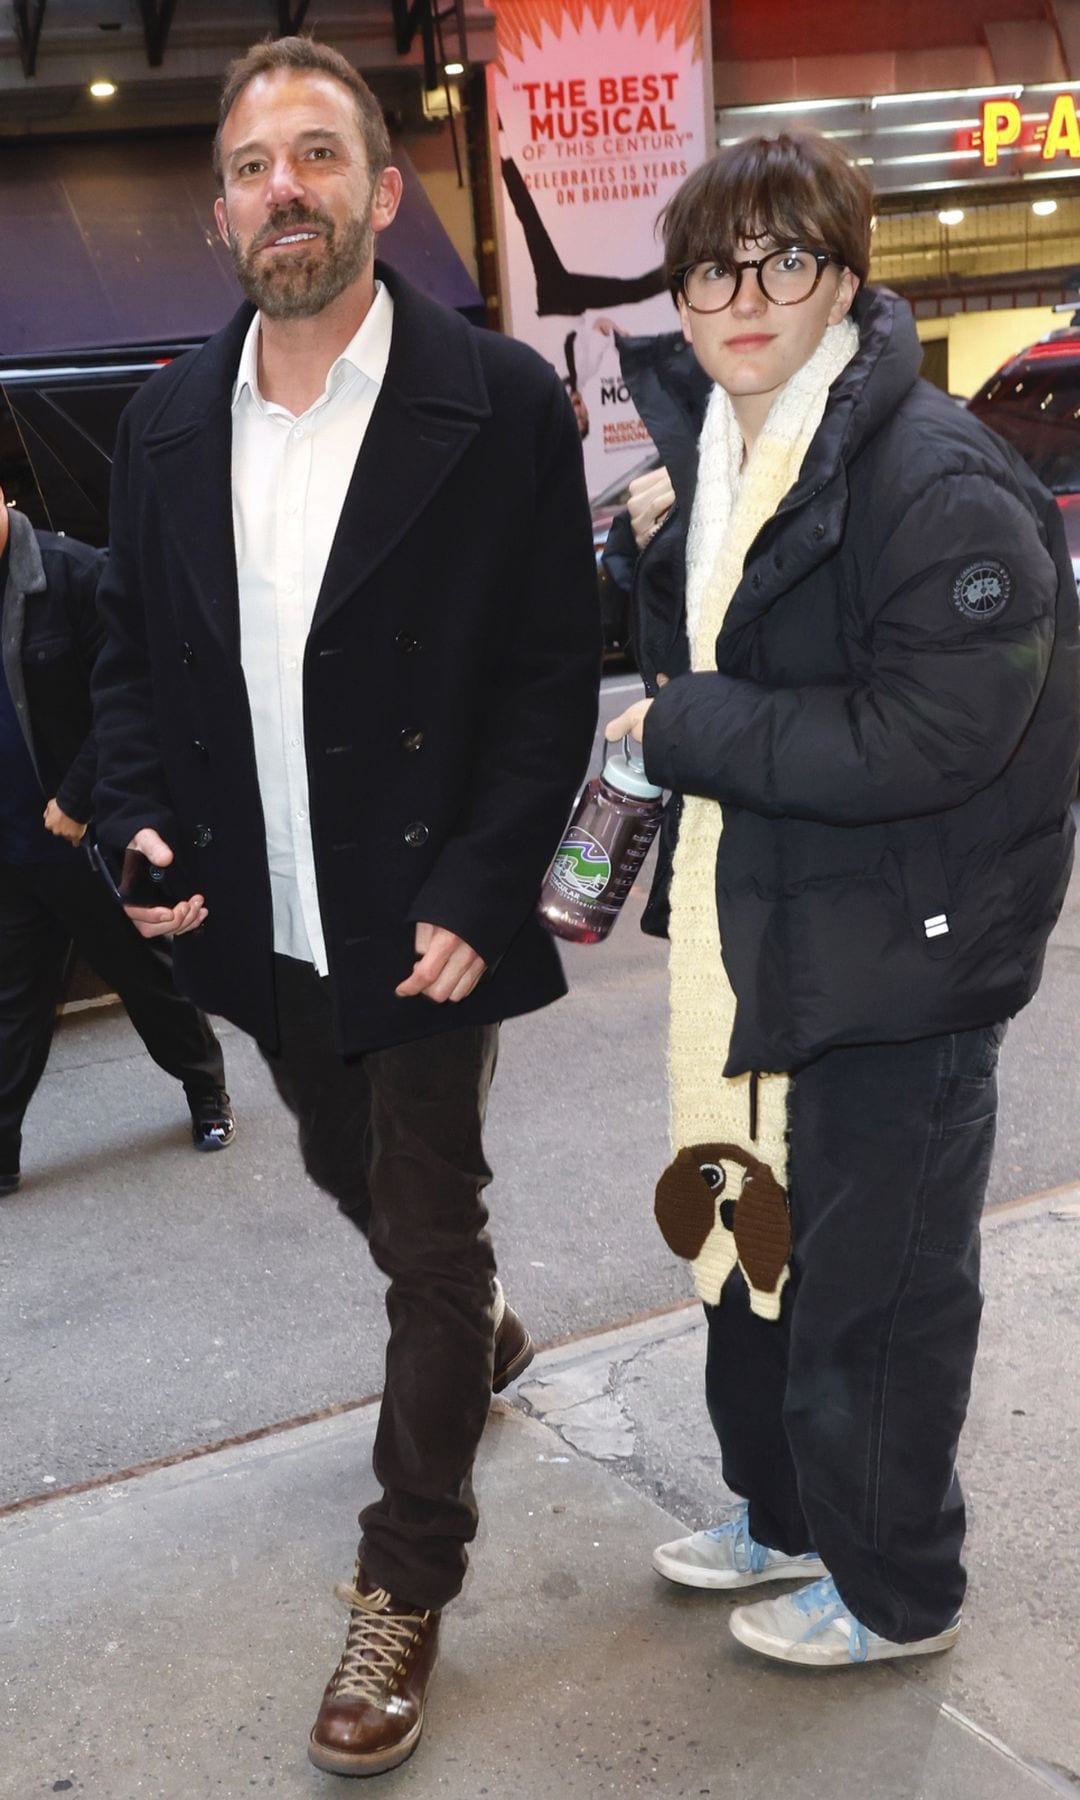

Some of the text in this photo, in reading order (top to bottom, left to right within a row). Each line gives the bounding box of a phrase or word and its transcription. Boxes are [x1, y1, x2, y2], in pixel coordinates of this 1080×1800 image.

[599, 74, 679, 105] BEST
[530, 106, 676, 142] MUSICAL
[522, 144, 547, 161] OF
[555, 140, 595, 157] THIS
[525, 161, 688, 190] CELEBRATES 15 YEARS
[557, 182, 658, 205] ON BROADWAY
